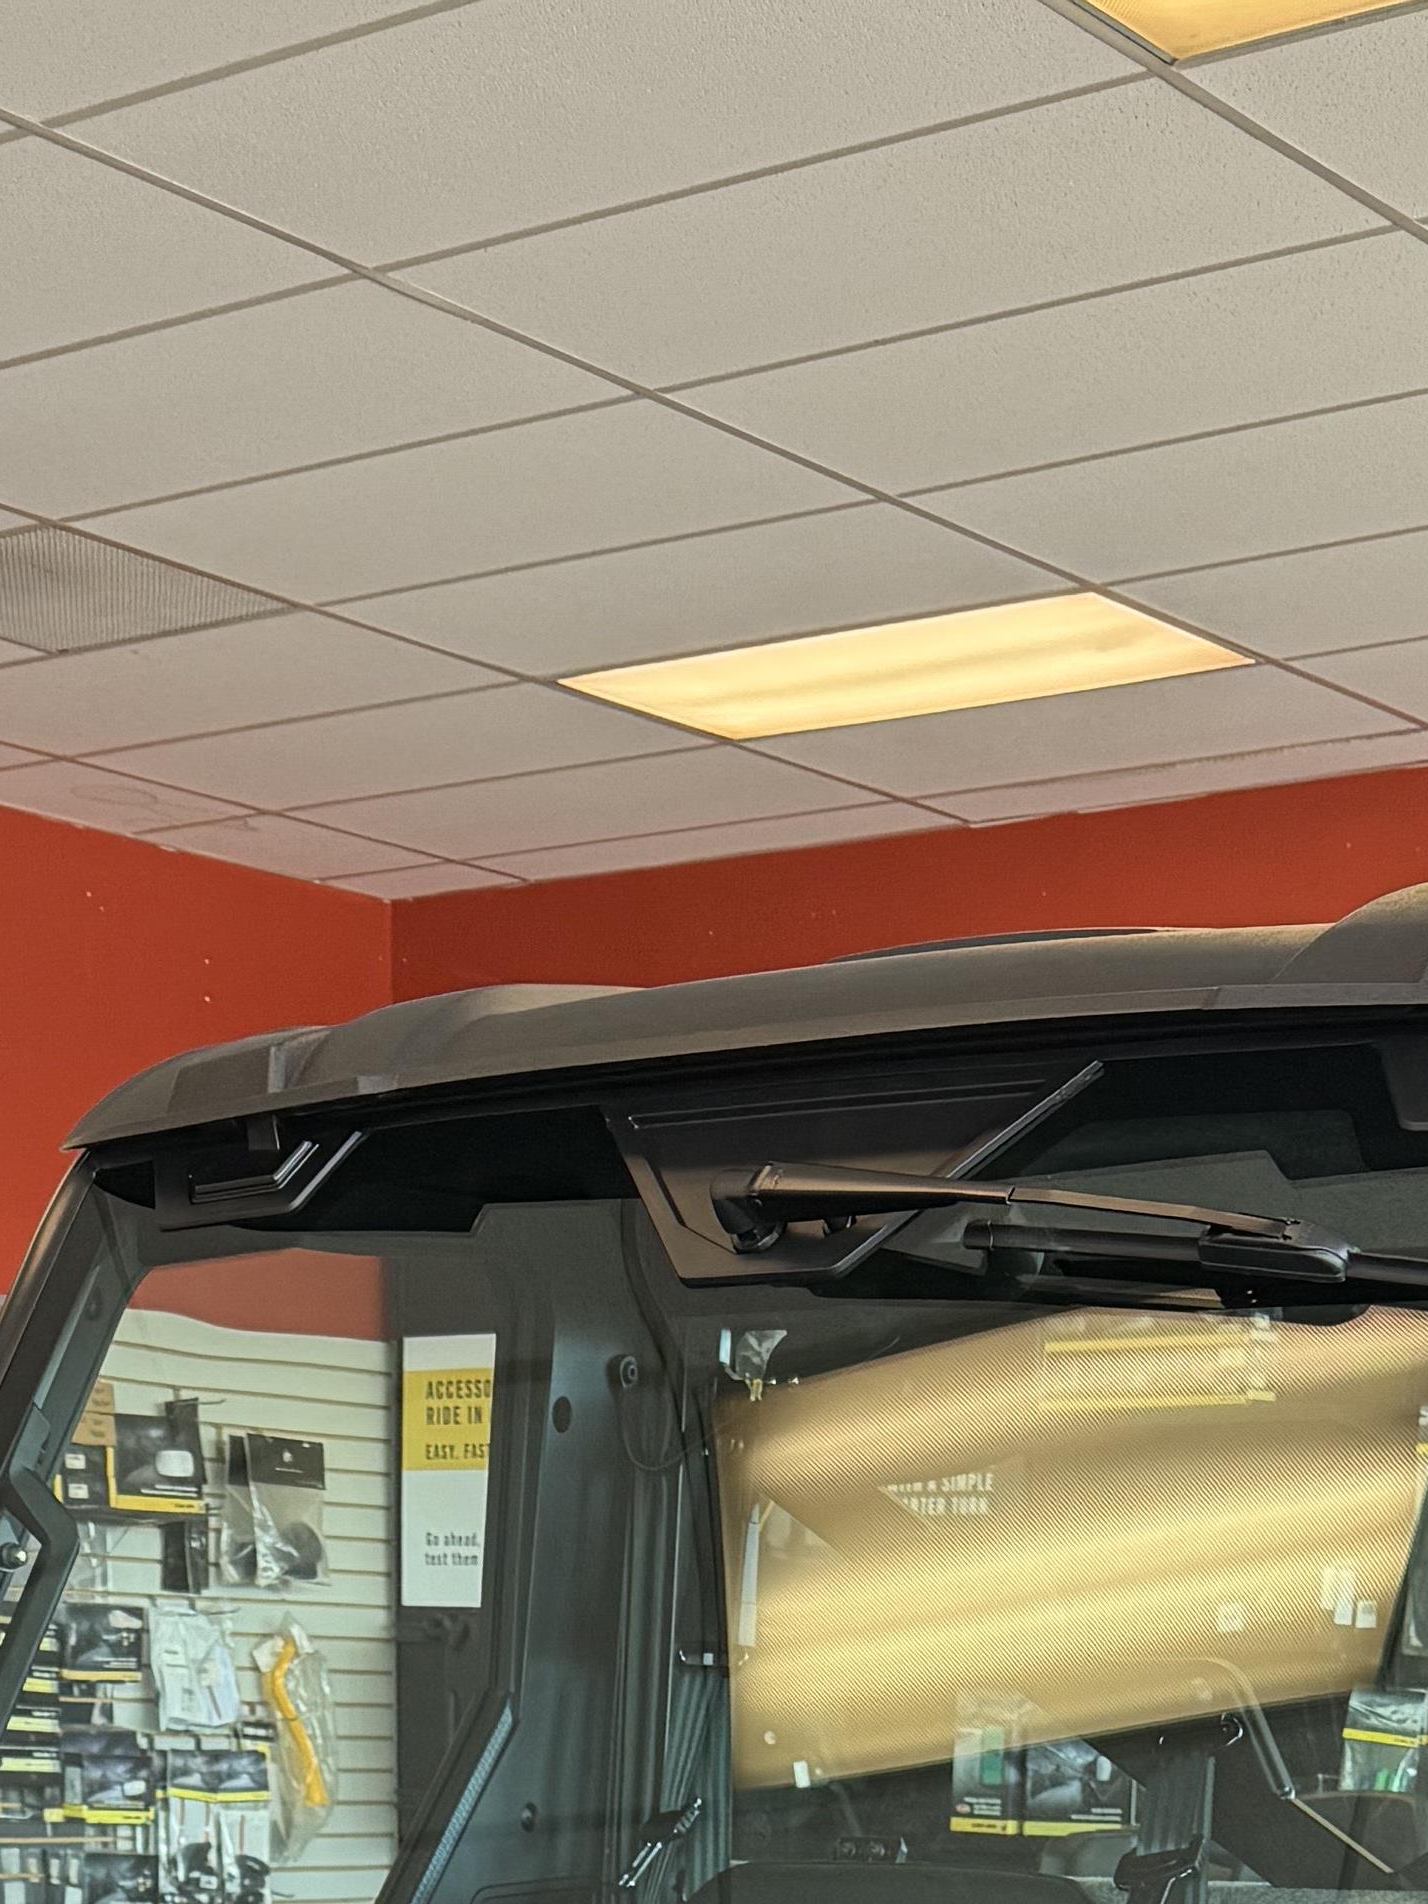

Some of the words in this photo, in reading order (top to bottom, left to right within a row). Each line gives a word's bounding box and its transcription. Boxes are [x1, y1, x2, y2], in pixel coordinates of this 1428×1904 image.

[425, 1405, 462, 1426] RIDE
[467, 1406, 483, 1425] IN
[425, 1443, 459, 1460] EASY.
[425, 1532, 440, 1546] Go
[425, 1553, 448, 1566] test
[451, 1553, 479, 1566] them
